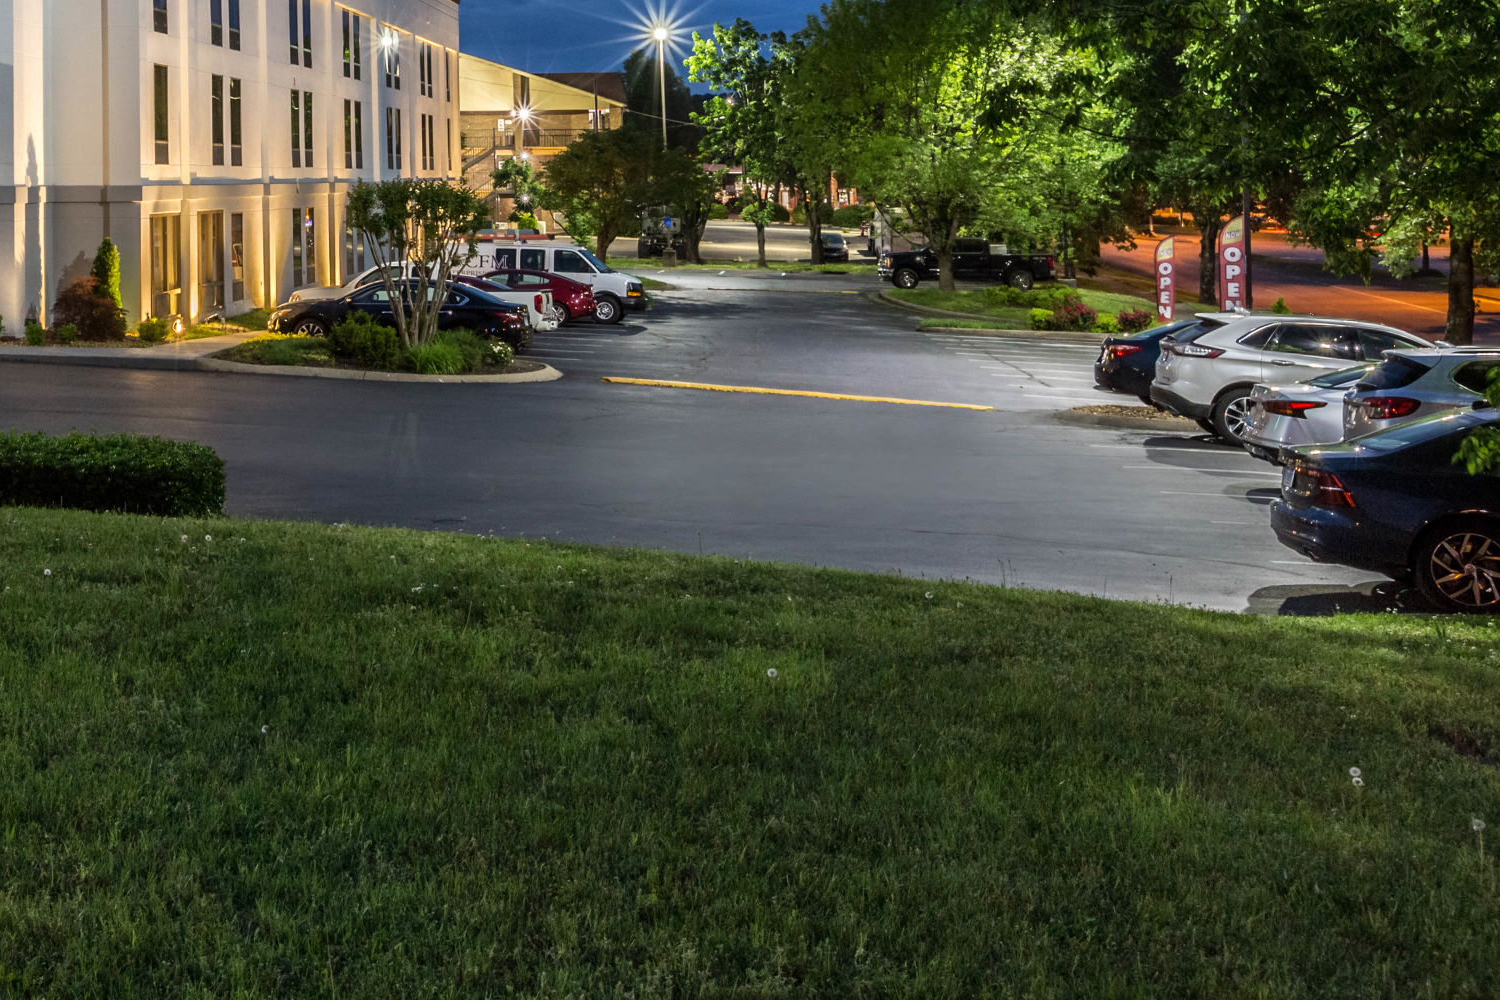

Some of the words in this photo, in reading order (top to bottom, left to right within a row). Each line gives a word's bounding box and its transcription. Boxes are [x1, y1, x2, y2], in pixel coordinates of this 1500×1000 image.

[1224, 229, 1241, 240] NOW
[1158, 262, 1173, 319] OPEN
[1223, 246, 1242, 311] OPEN
